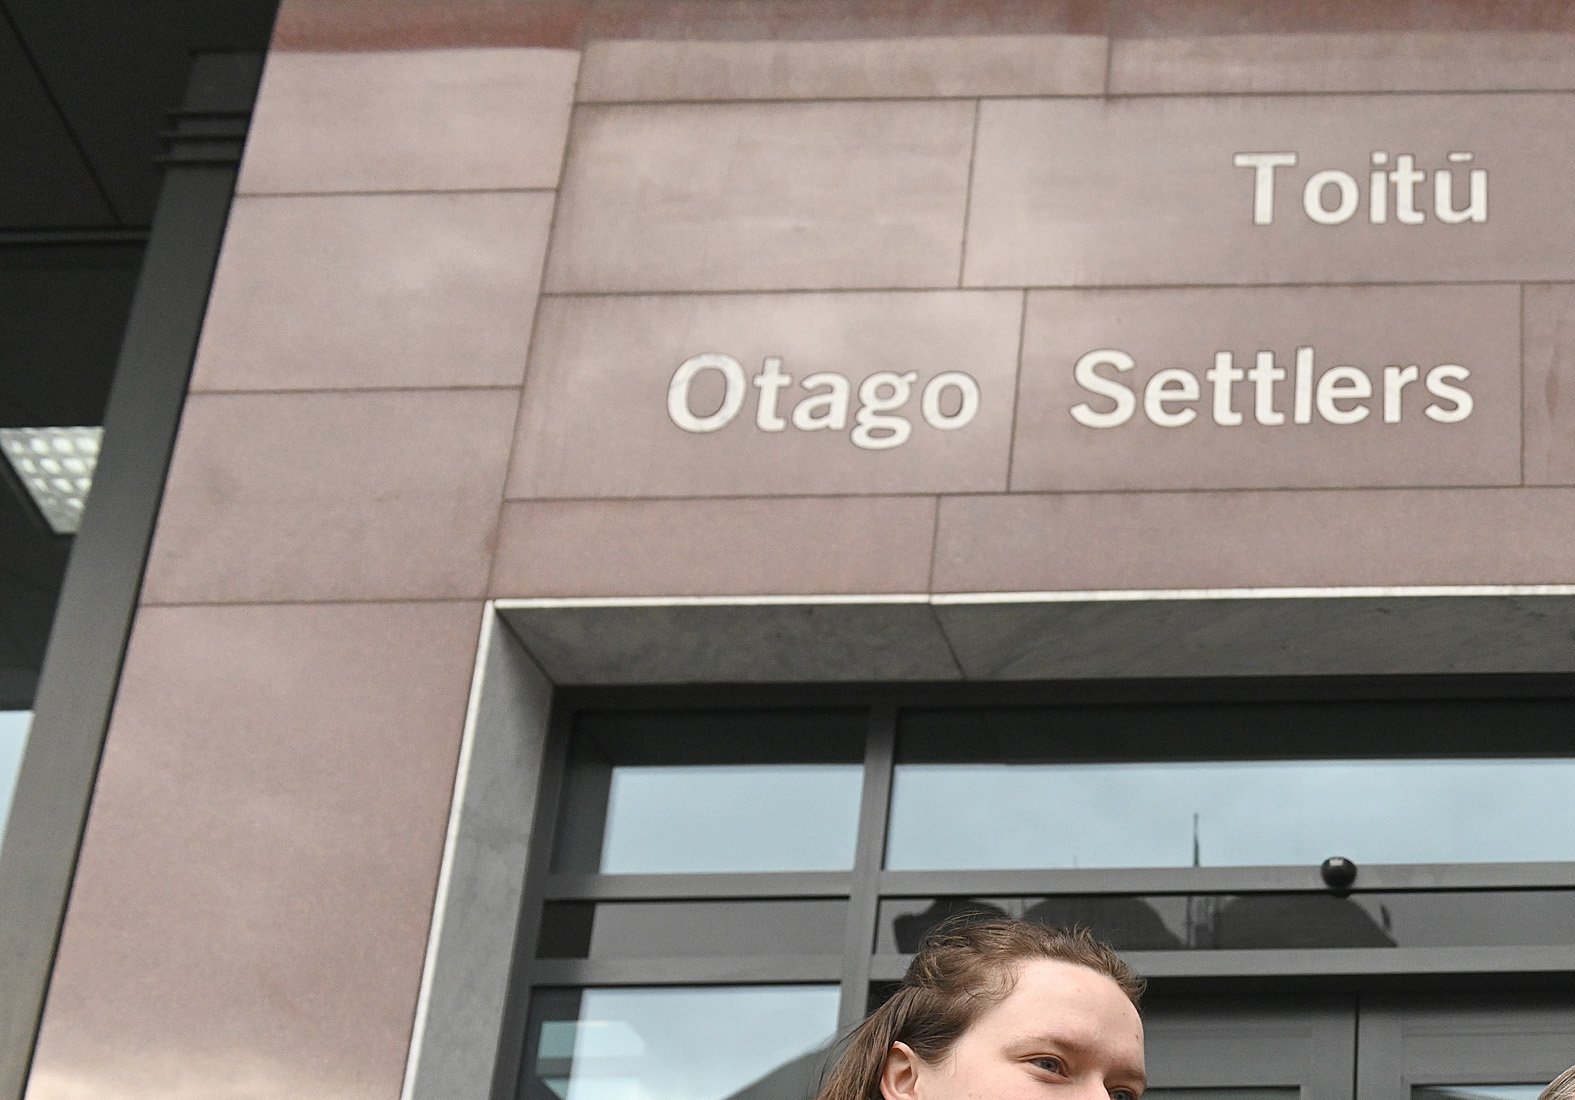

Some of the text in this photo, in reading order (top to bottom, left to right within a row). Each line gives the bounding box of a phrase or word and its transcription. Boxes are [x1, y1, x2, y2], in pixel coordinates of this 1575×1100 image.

[1232, 151, 1488, 225] Toitū
[667, 353, 980, 449] Otago
[1069, 347, 1474, 429] Settlers
